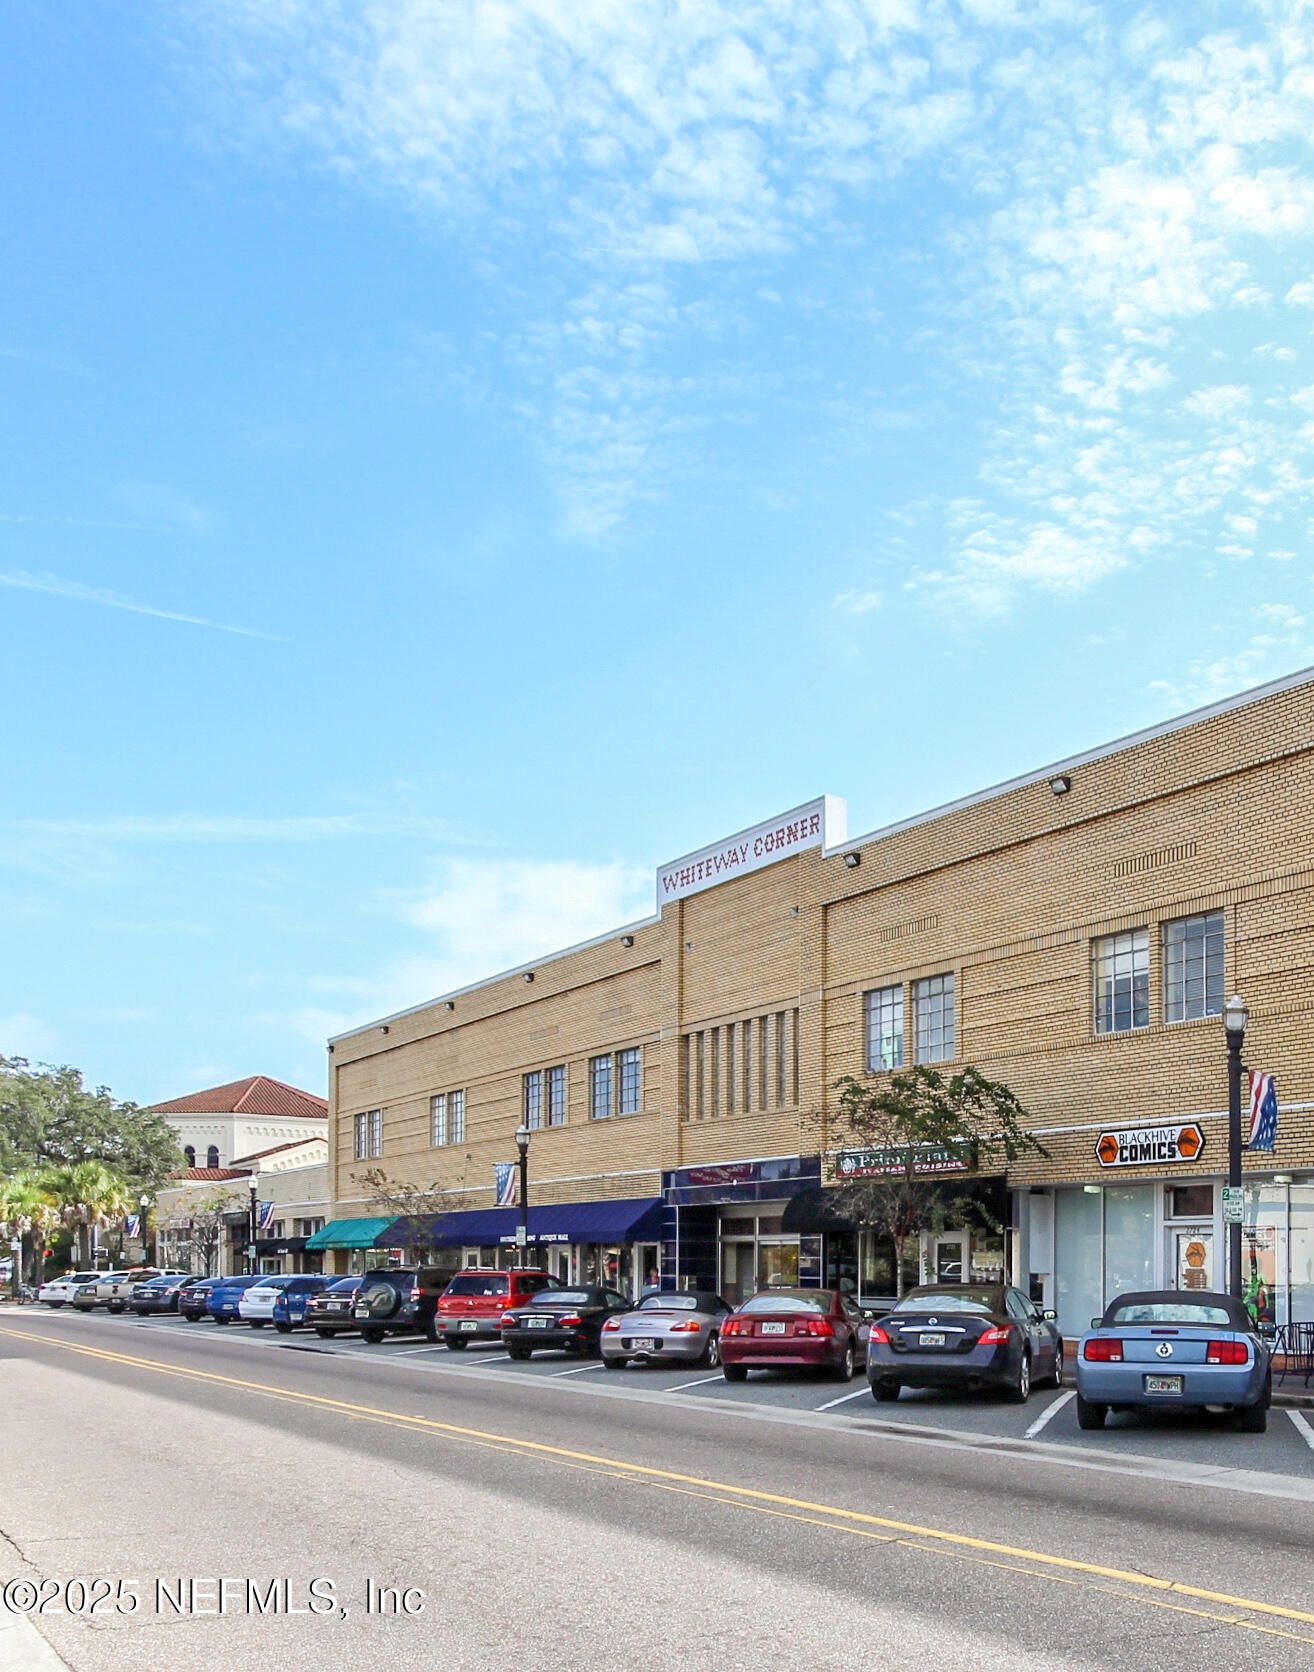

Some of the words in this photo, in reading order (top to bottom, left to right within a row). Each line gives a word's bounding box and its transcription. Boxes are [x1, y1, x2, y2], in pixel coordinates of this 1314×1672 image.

[662, 843, 749, 894] WHITEWAY
[753, 813, 821, 857] CORNER
[1118, 1129, 1177, 1145] BLACKHIVE
[1119, 1141, 1177, 1162] COMICS
[1223, 1189, 1229, 1199] 2
